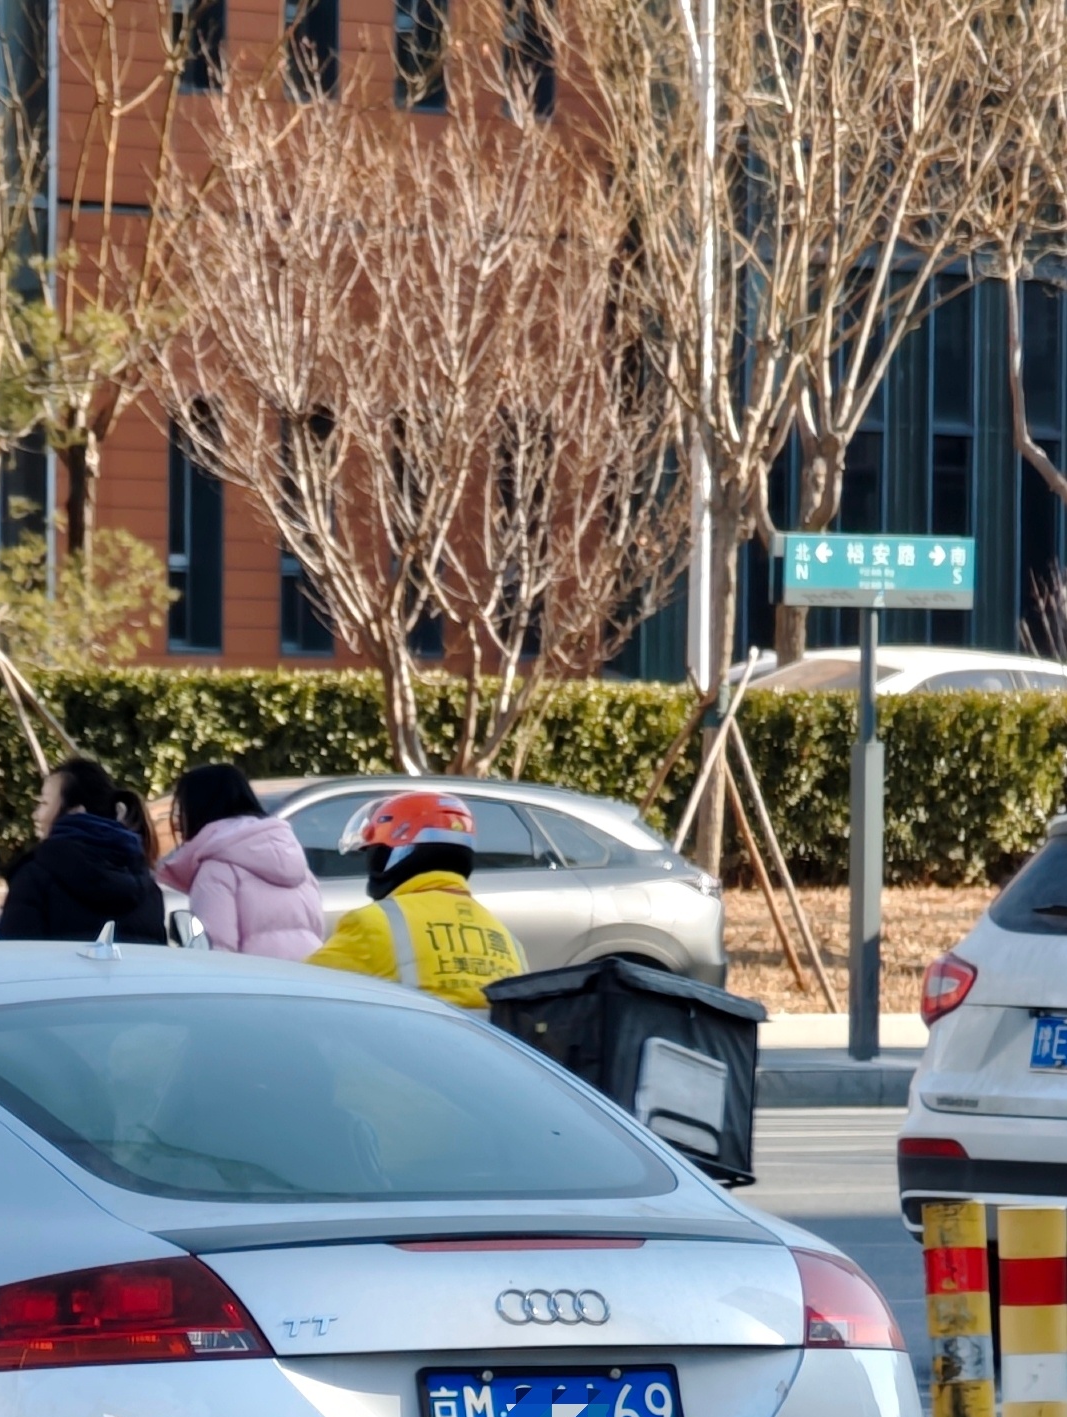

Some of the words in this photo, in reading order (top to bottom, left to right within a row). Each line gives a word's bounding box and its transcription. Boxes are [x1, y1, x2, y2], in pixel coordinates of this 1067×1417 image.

[795, 542, 811, 562] 北
[950, 545, 967, 567] 南
[795, 563, 809, 580] N
[953, 568, 963, 585] S
[282, 1314, 338, 1338] TT
